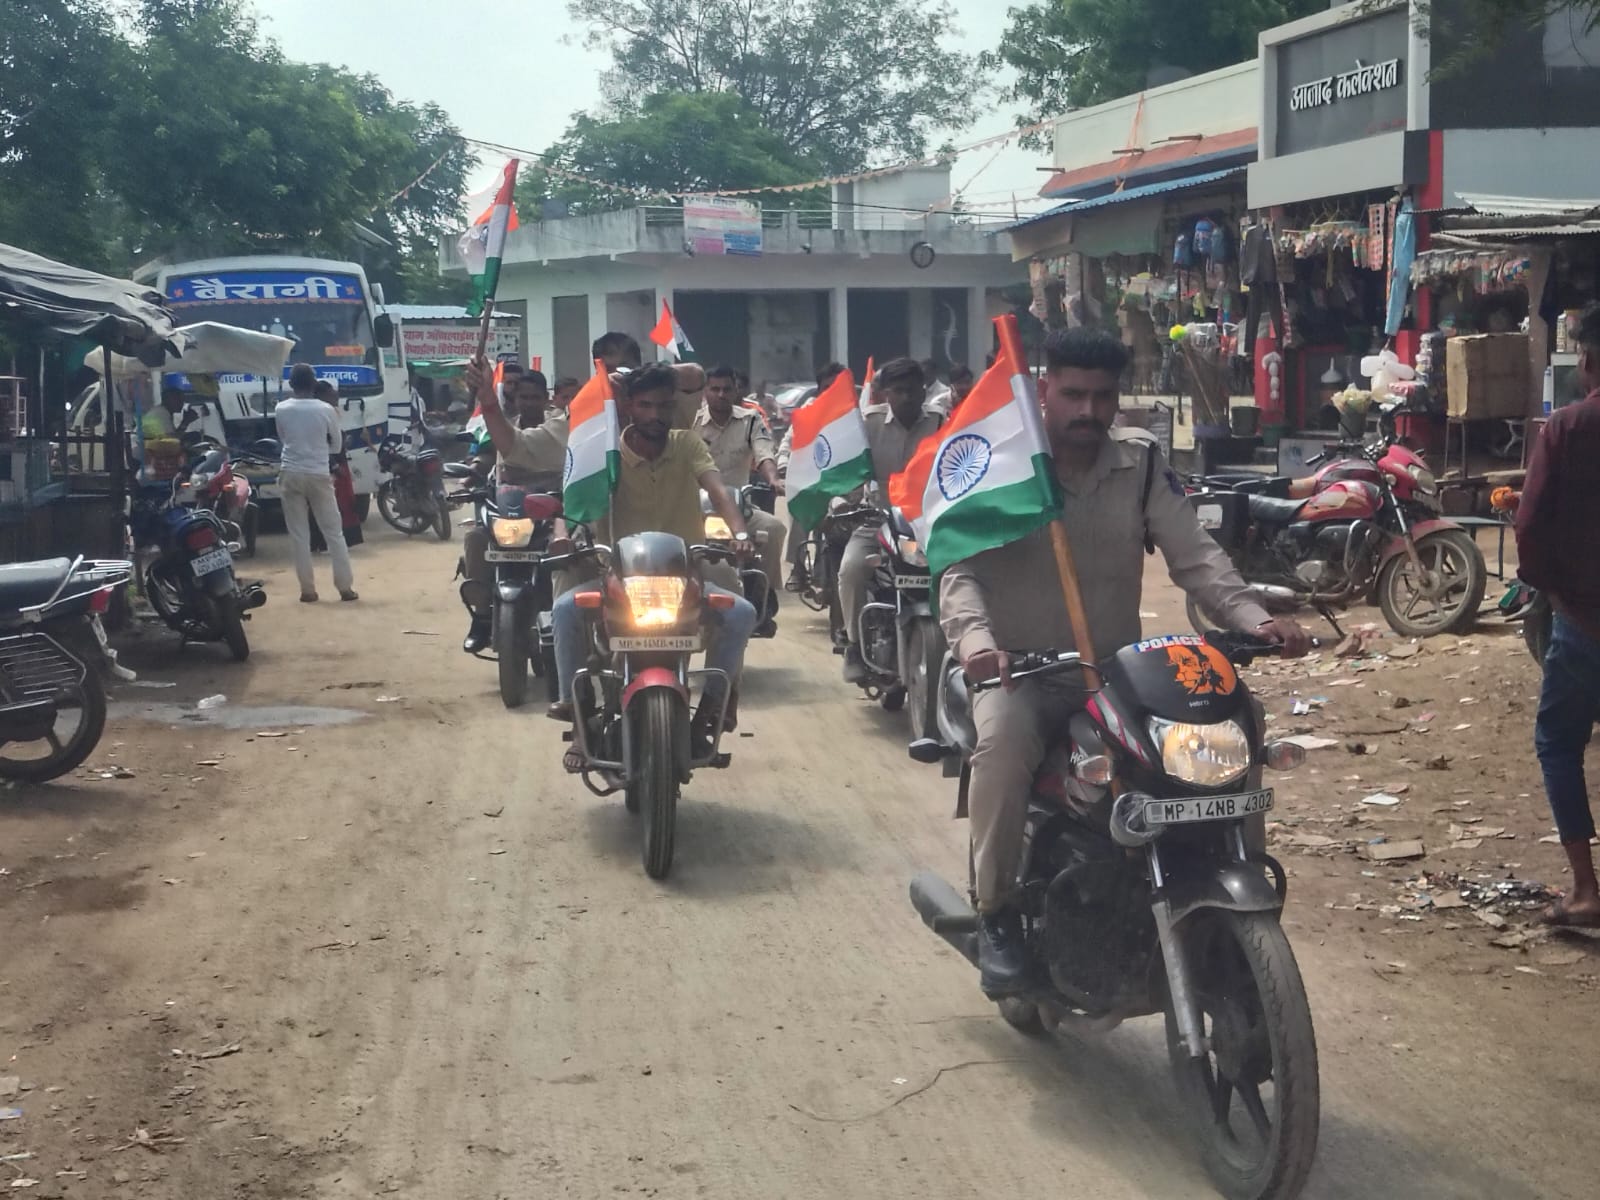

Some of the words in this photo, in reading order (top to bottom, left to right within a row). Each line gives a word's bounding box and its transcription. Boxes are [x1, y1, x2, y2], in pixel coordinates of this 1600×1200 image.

[190, 277, 341, 300] बैरागी
[1137, 635, 1205, 653] POLICE
[1164, 805, 1185, 821] MP
[1243, 792, 1273, 811] 4302
